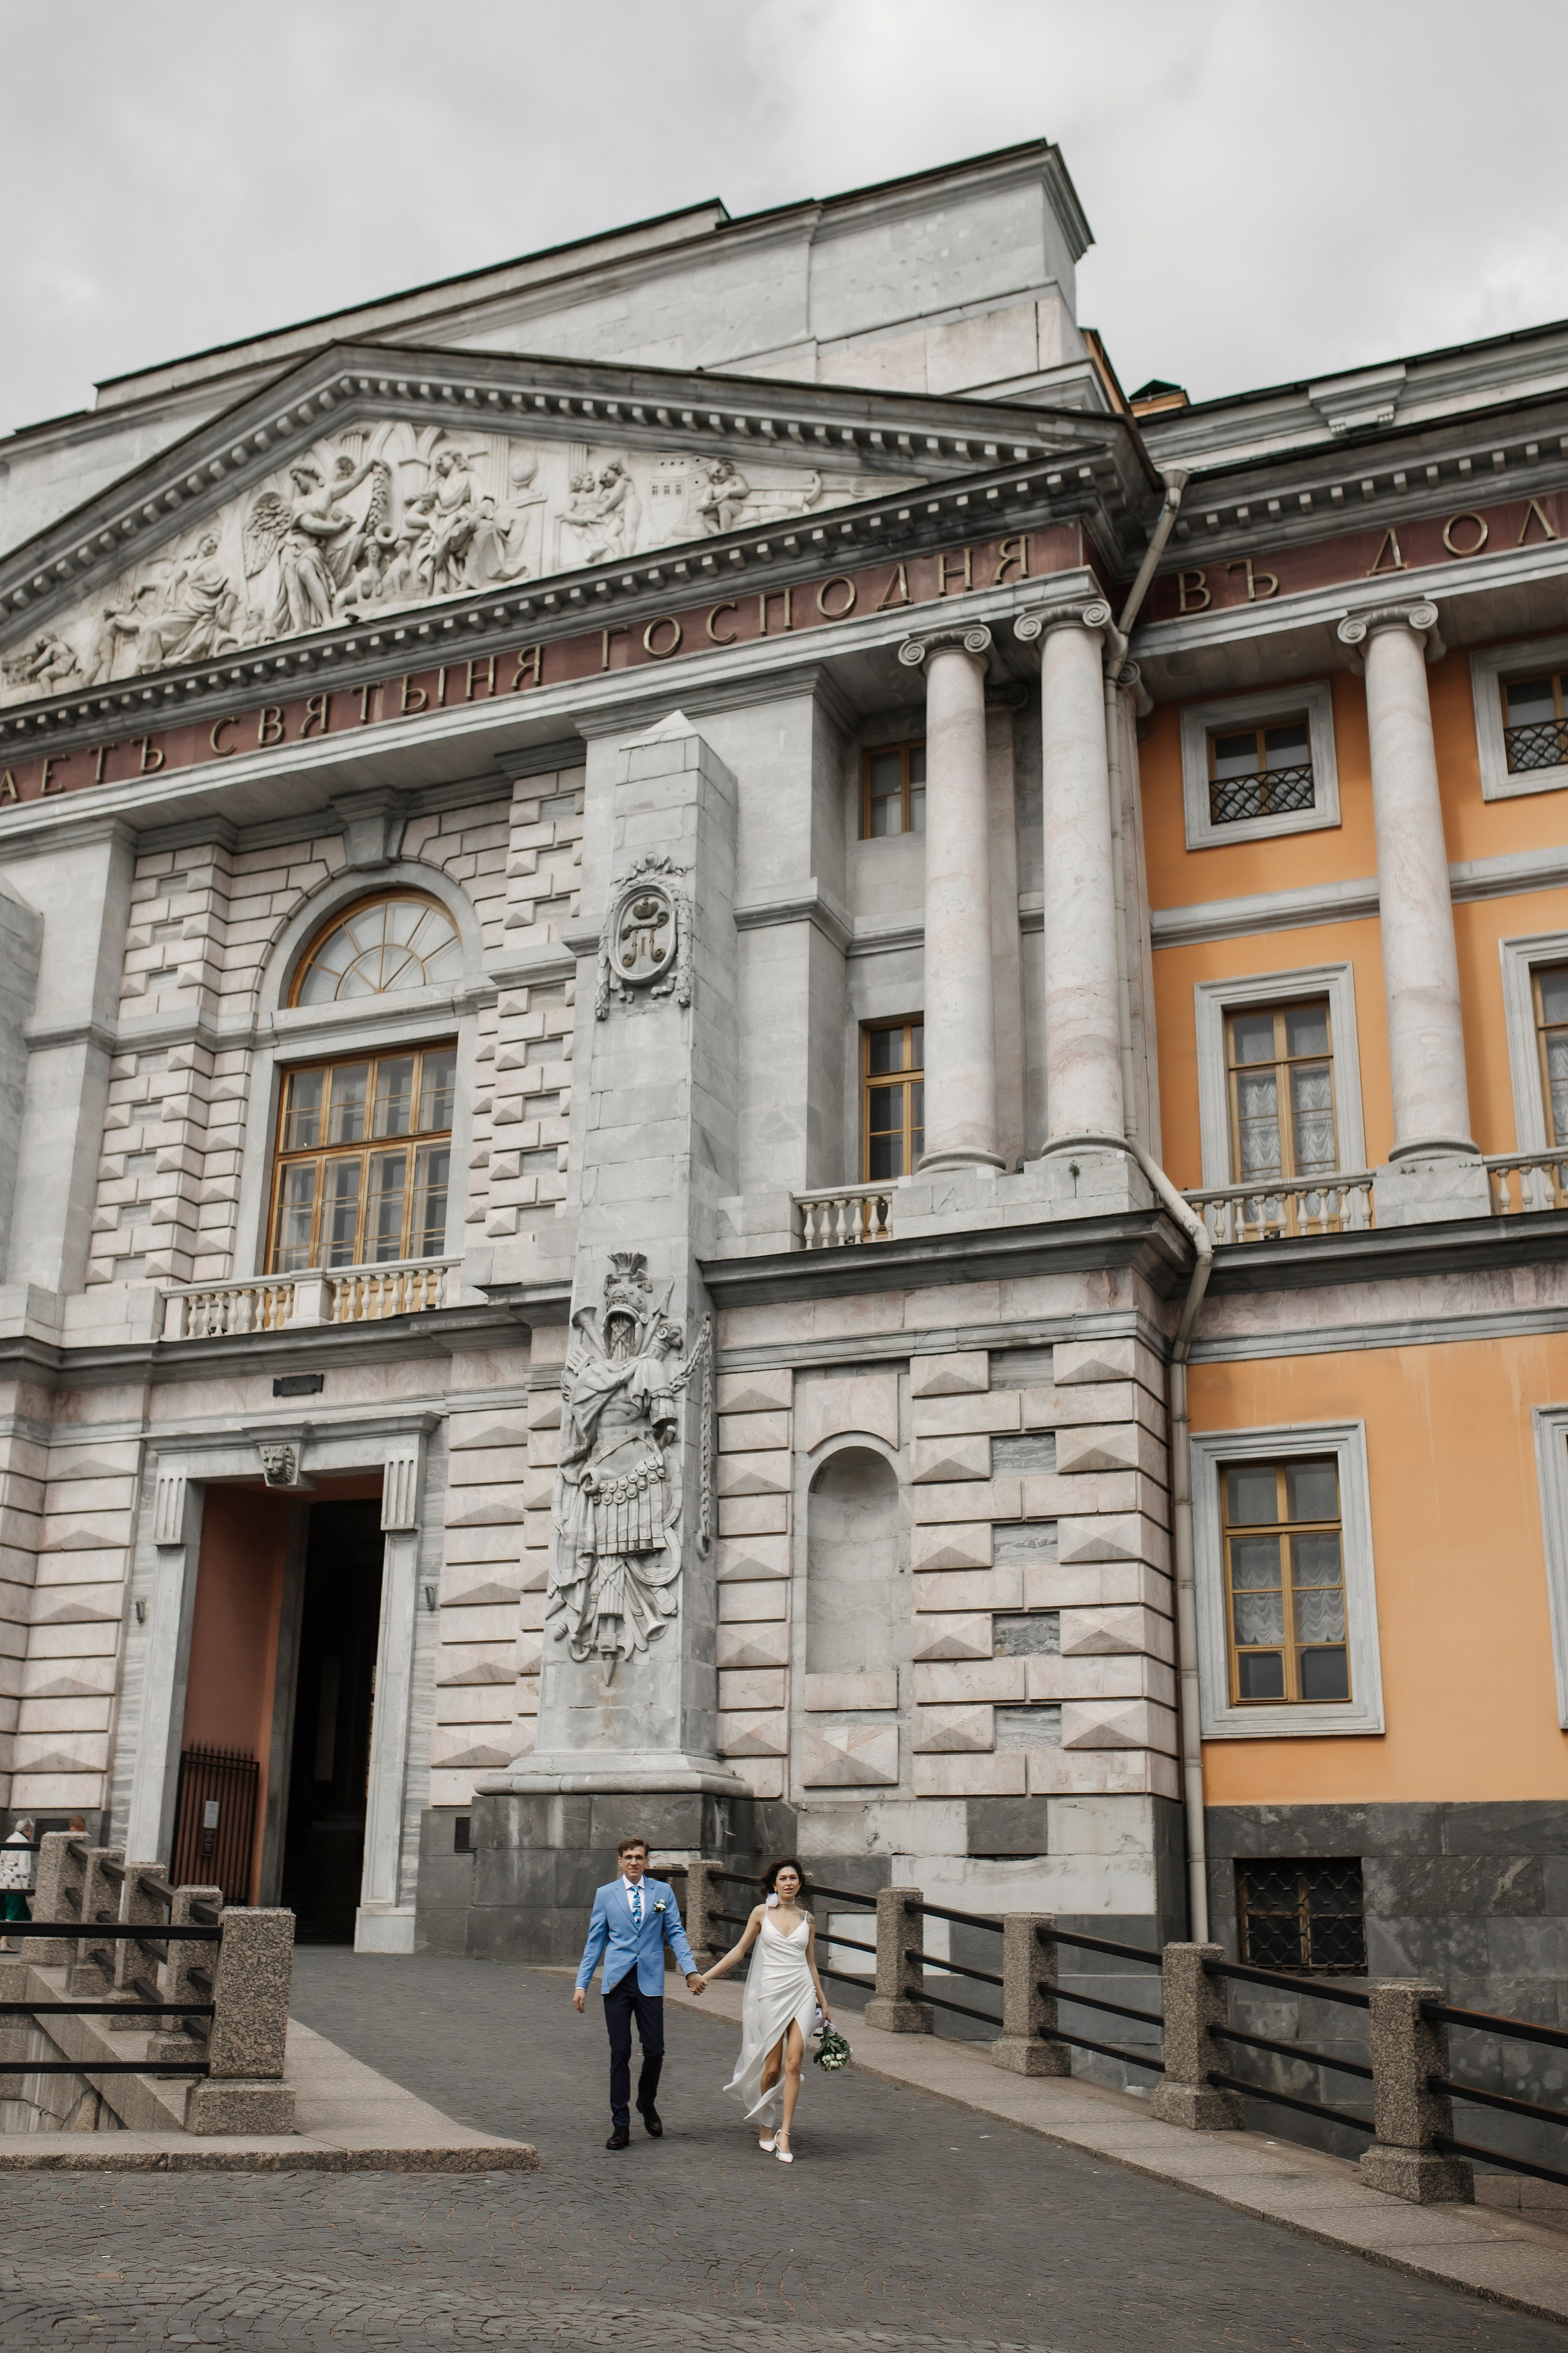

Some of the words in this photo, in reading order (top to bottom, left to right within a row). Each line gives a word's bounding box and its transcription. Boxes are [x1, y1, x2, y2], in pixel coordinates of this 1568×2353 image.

[0, 735, 165, 803] АЕТЪ
[209, 644, 541, 757] СВЯТЫНЯ
[601, 534, 1030, 672] ГОСПОДНЯ
[1178, 558, 1279, 613] ВЪ
